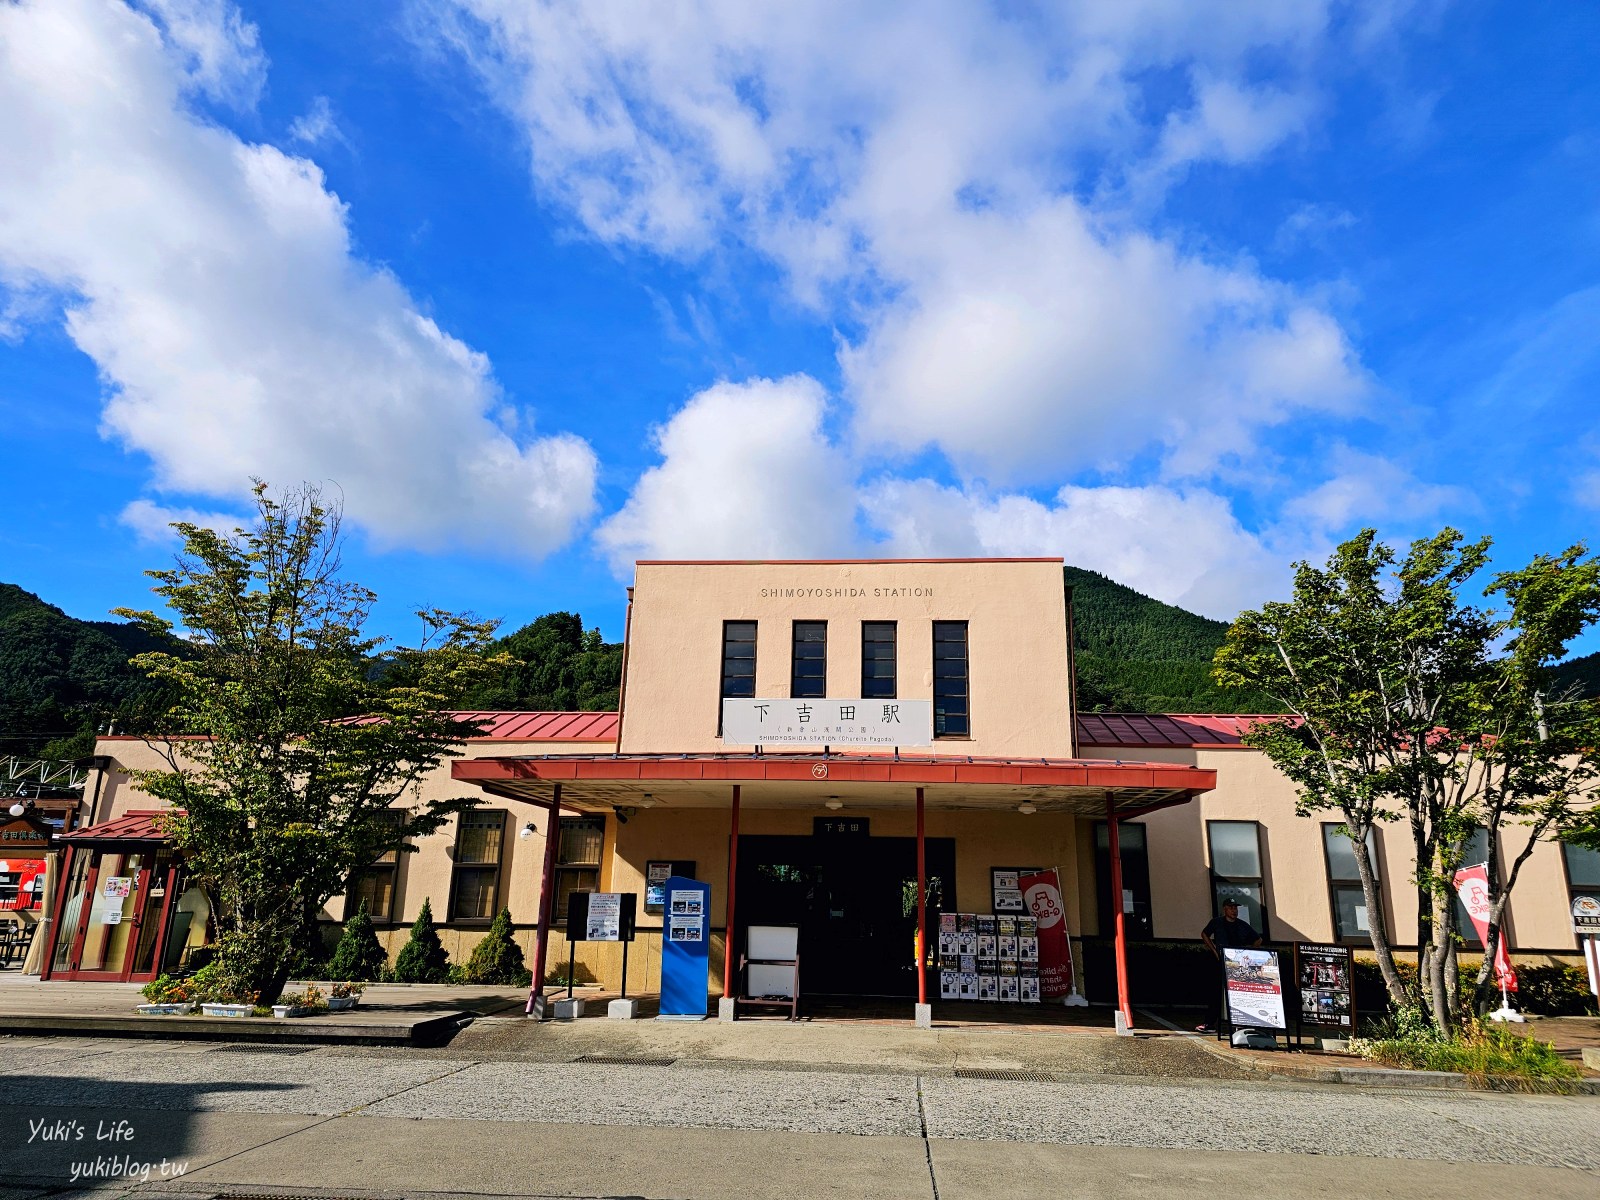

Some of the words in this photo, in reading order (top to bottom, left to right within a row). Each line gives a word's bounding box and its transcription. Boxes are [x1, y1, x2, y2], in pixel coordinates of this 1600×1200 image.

[761, 588, 866, 597] SHIMOYOSHIDA
[874, 588, 933, 597] STATION
[754, 703, 901, 724] 下吉田駅
[824, 822, 859, 832] 下吉田
